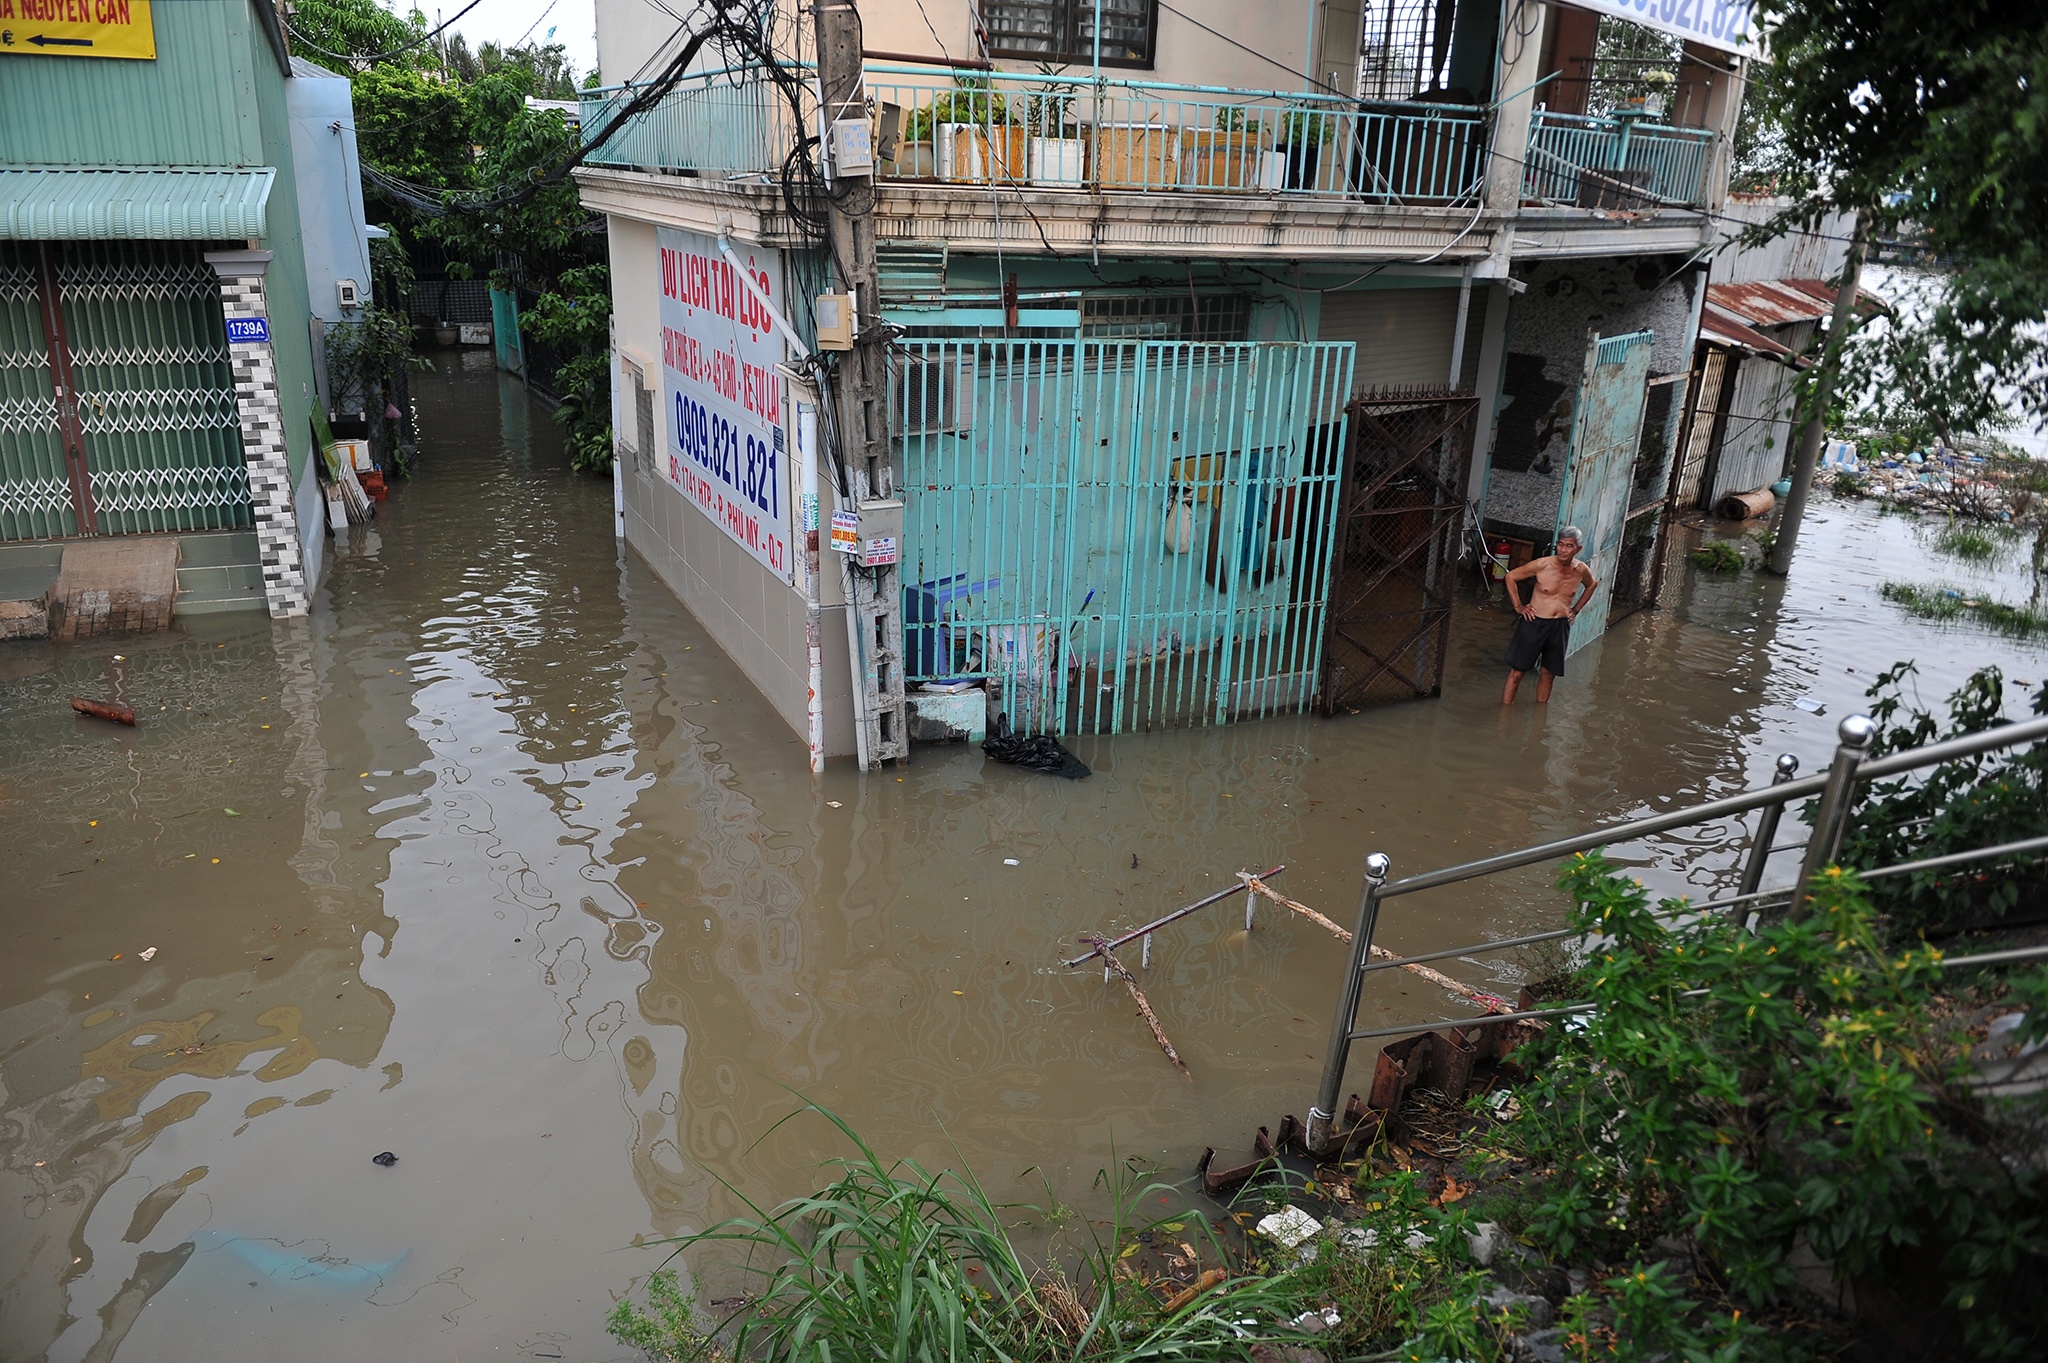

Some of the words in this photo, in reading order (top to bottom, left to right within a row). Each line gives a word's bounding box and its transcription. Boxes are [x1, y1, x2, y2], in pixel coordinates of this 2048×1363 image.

[0, 0, 15, 19] A
[661, 247, 677, 300] DU
[679, 251, 711, 317] LỊCH
[230, 321, 265, 336] 1739A
[663, 325, 674, 368] CHO
[688, 337, 698, 382] XE
[713, 348, 722, 395] 45
[743, 361, 754, 412] XE
[767, 363, 780, 427] LÁI
[675, 390, 778, 520] 0909.821.821
[682, 465, 697, 500] 1741
[698, 477, 712, 511] HTP
[728, 502, 745, 540] PHÚ
[769, 533, 783, 571] Q.7
